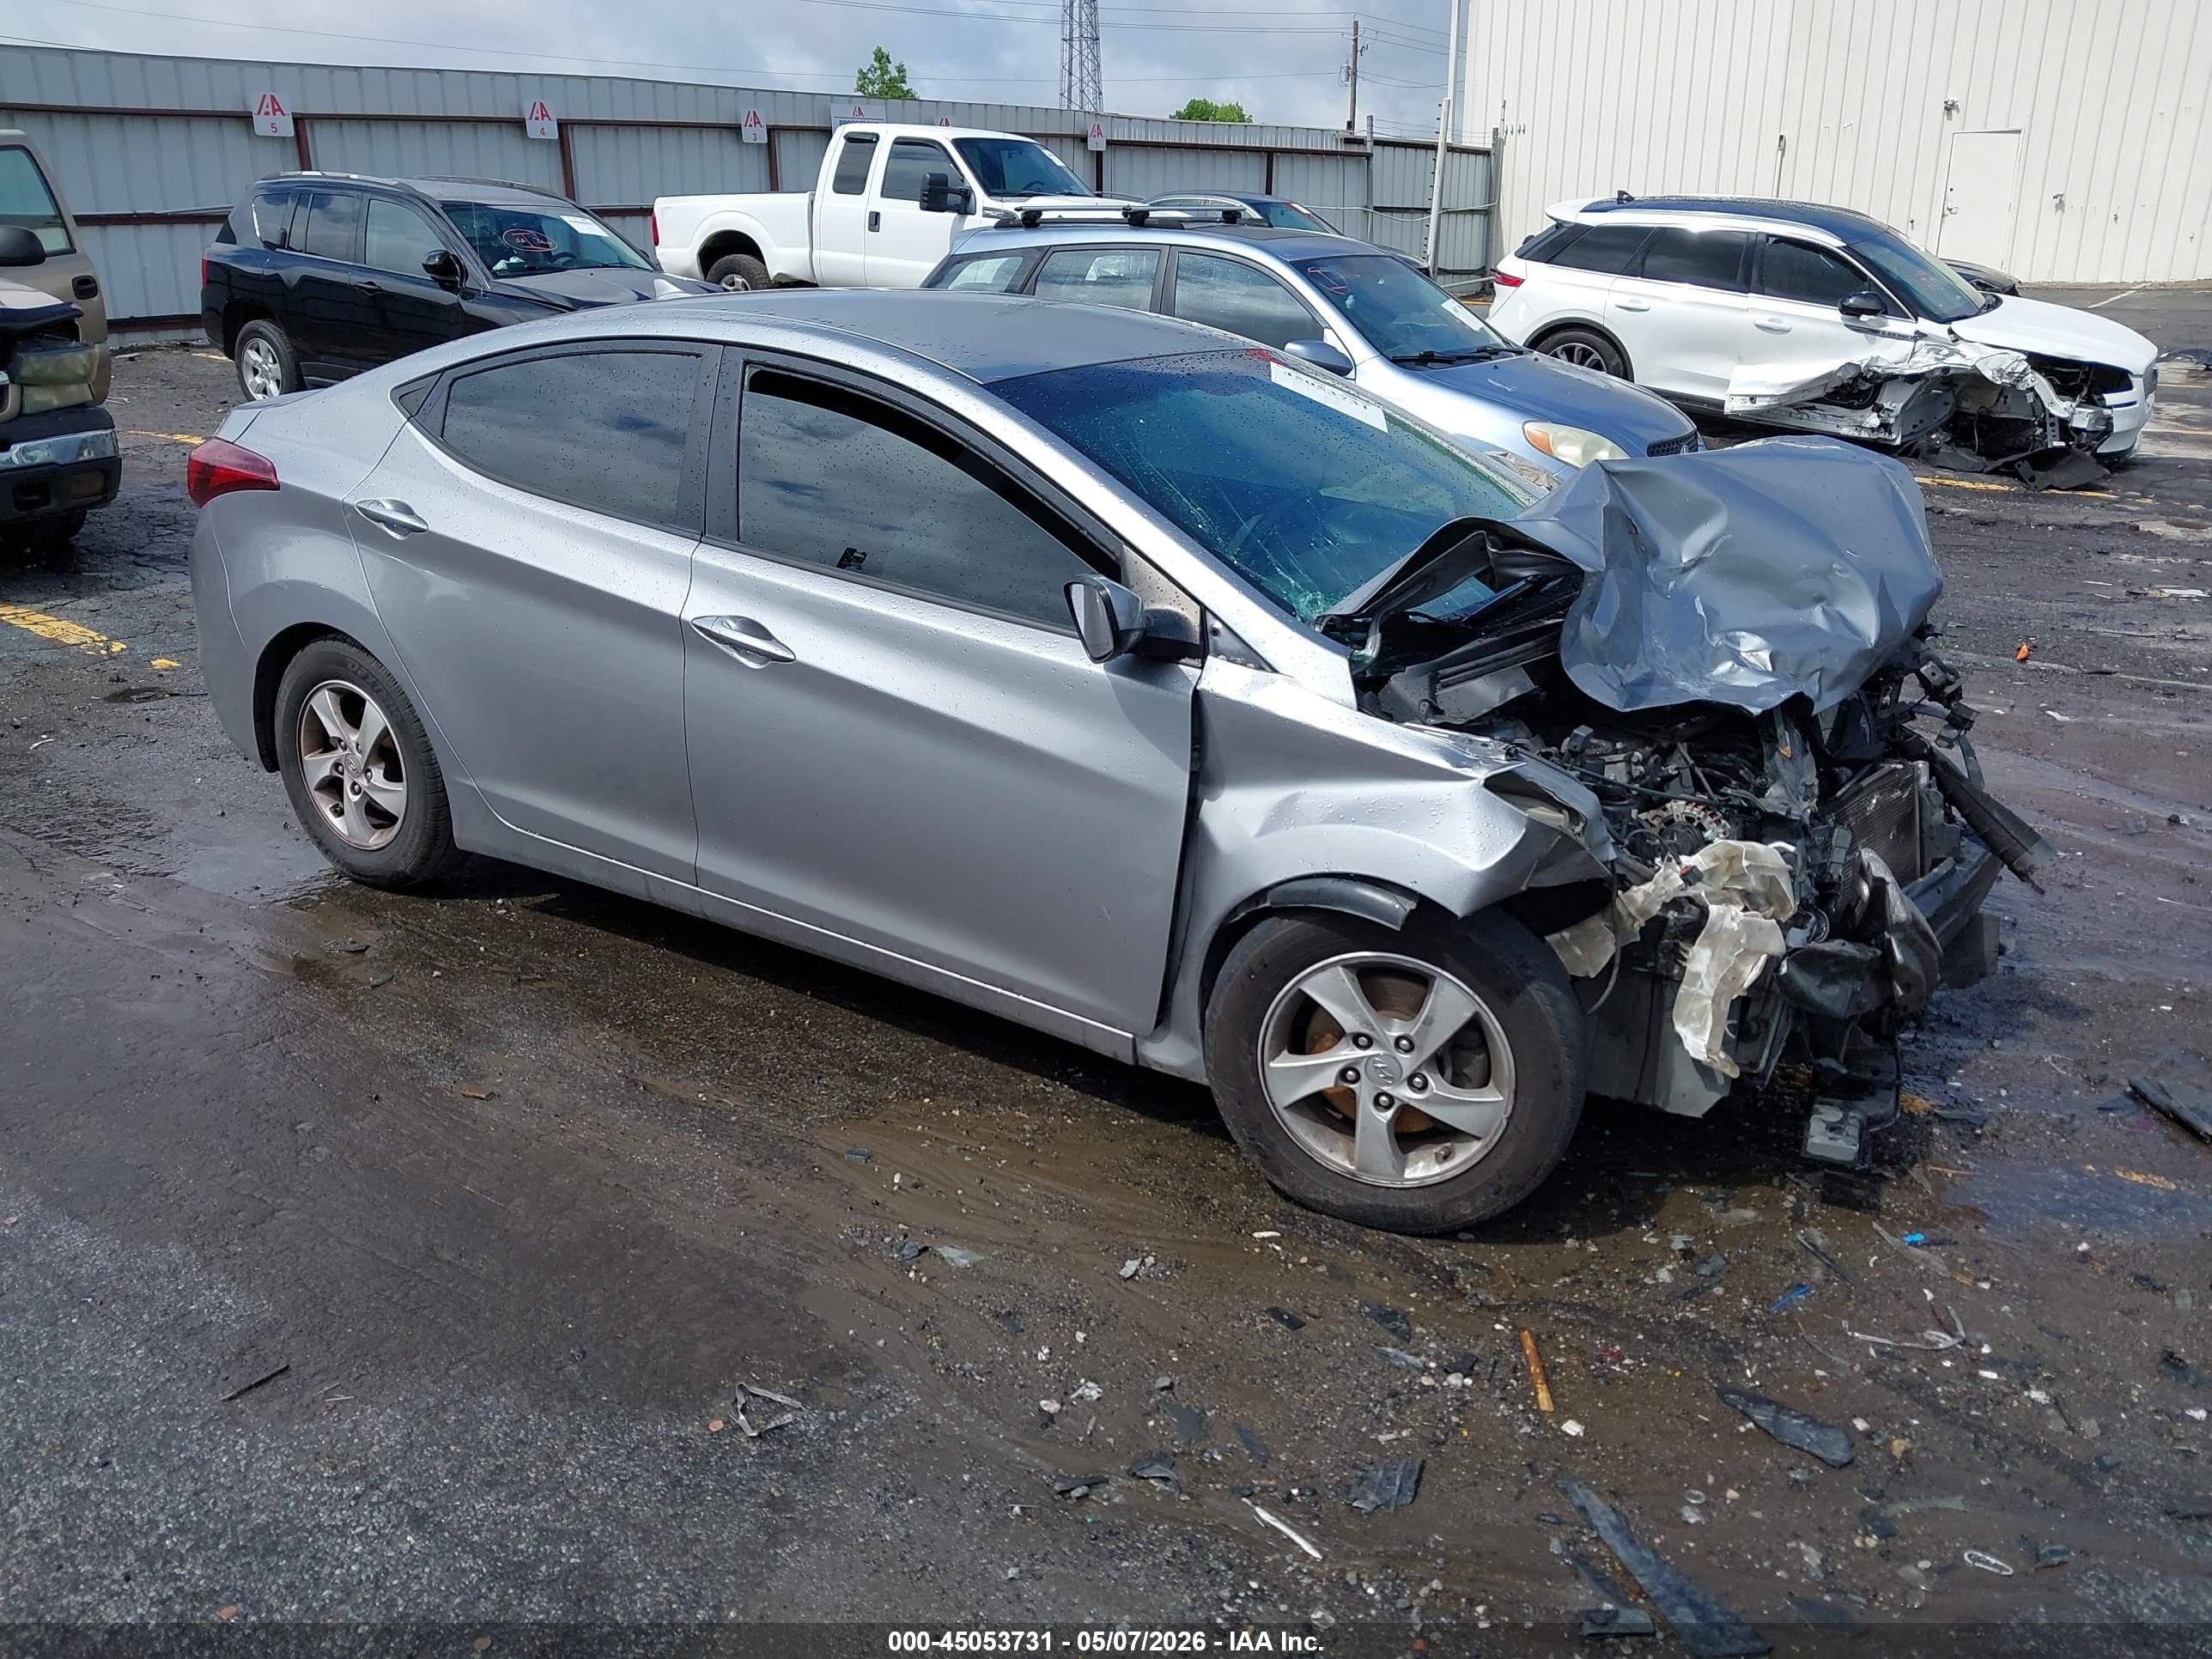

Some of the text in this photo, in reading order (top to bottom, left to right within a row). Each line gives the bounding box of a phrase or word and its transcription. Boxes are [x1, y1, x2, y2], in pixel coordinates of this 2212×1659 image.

[270, 123, 278, 133] 5
[539, 126, 545, 137] 4
[751, 132, 757, 142] 3
